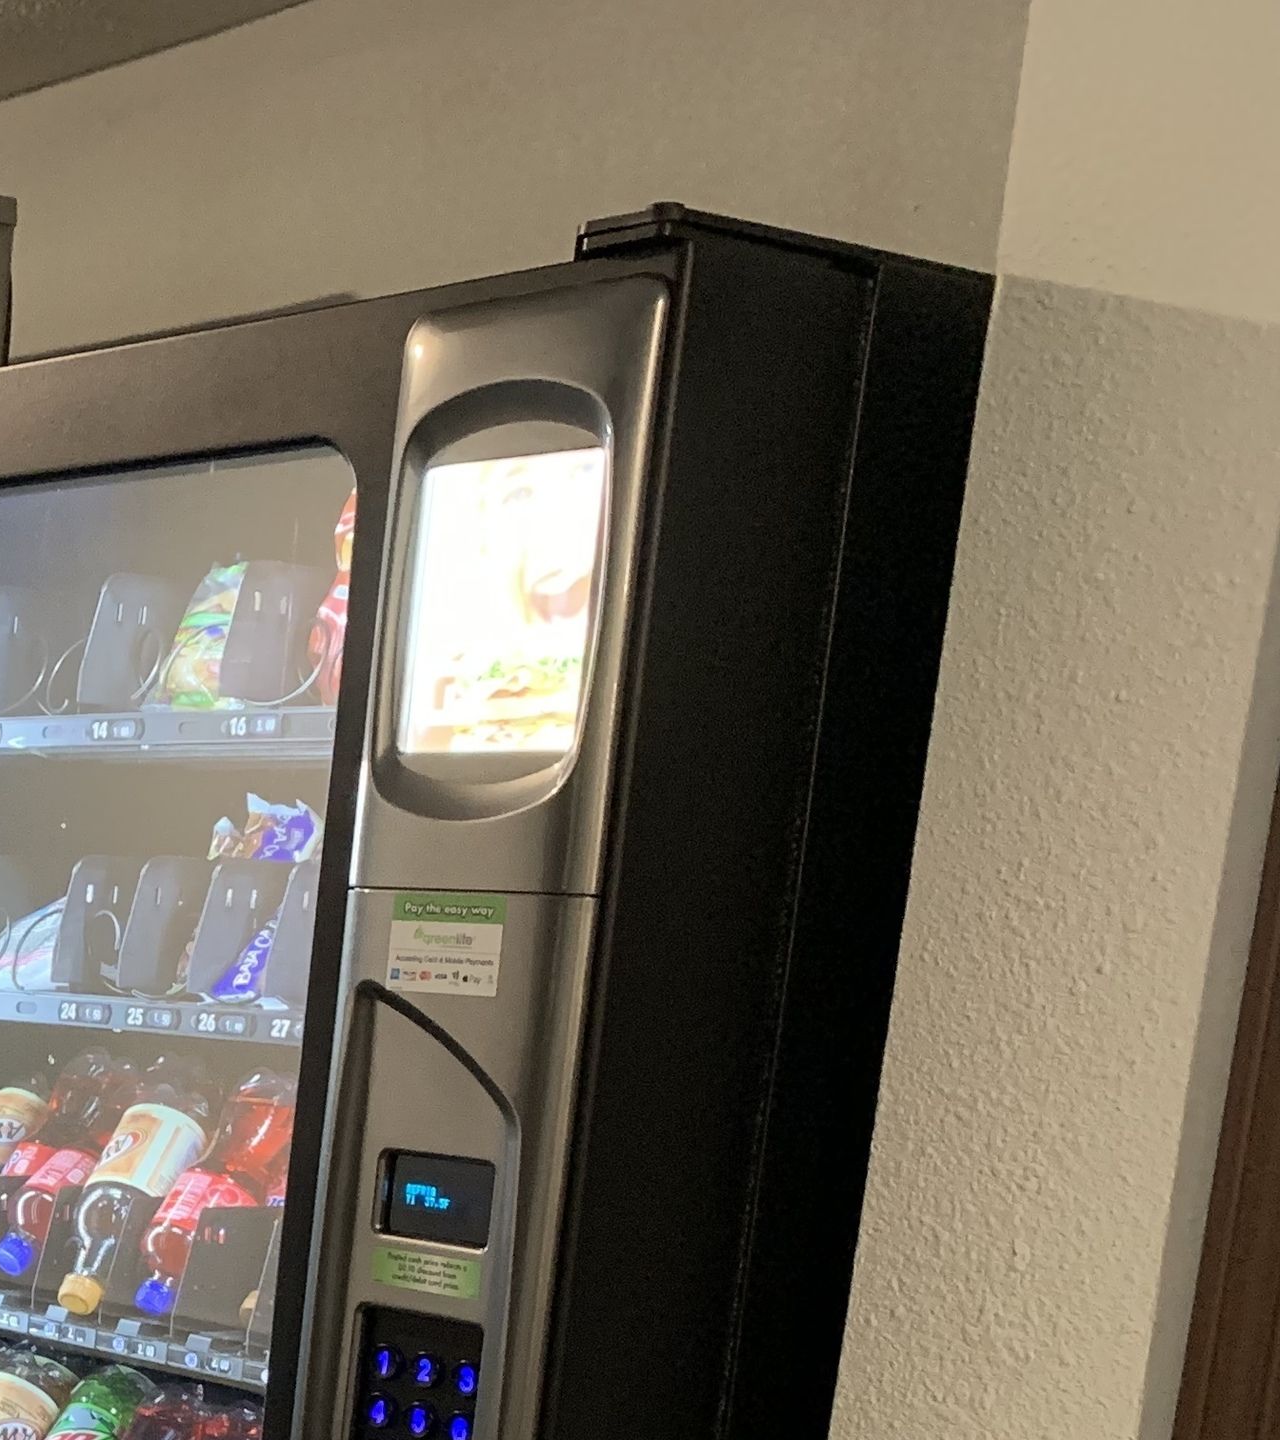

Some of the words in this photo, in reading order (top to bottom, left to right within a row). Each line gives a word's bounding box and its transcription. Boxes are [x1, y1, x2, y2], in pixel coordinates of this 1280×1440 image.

[92, 721, 107, 739] 14
[229, 717, 246, 736] 16
[405, 902, 423, 915] Pay
[426, 903, 441, 913] the
[444, 905, 467, 916] easy
[471, 907, 494, 918] way
[233, 950, 259, 990] BAJA
[61, 1002, 76, 1020] 24
[128, 1007, 143, 1025] 25
[198, 1014, 215, 1031] 26
[271, 1019, 290, 1038] 27
[378, 1350, 389, 1376] 1
[417, 1358, 431, 1383] 2
[458, 1366, 475, 1392] 3
[371, 1400, 386, 1425] 4
[411, 1408, 427, 1433] 5
